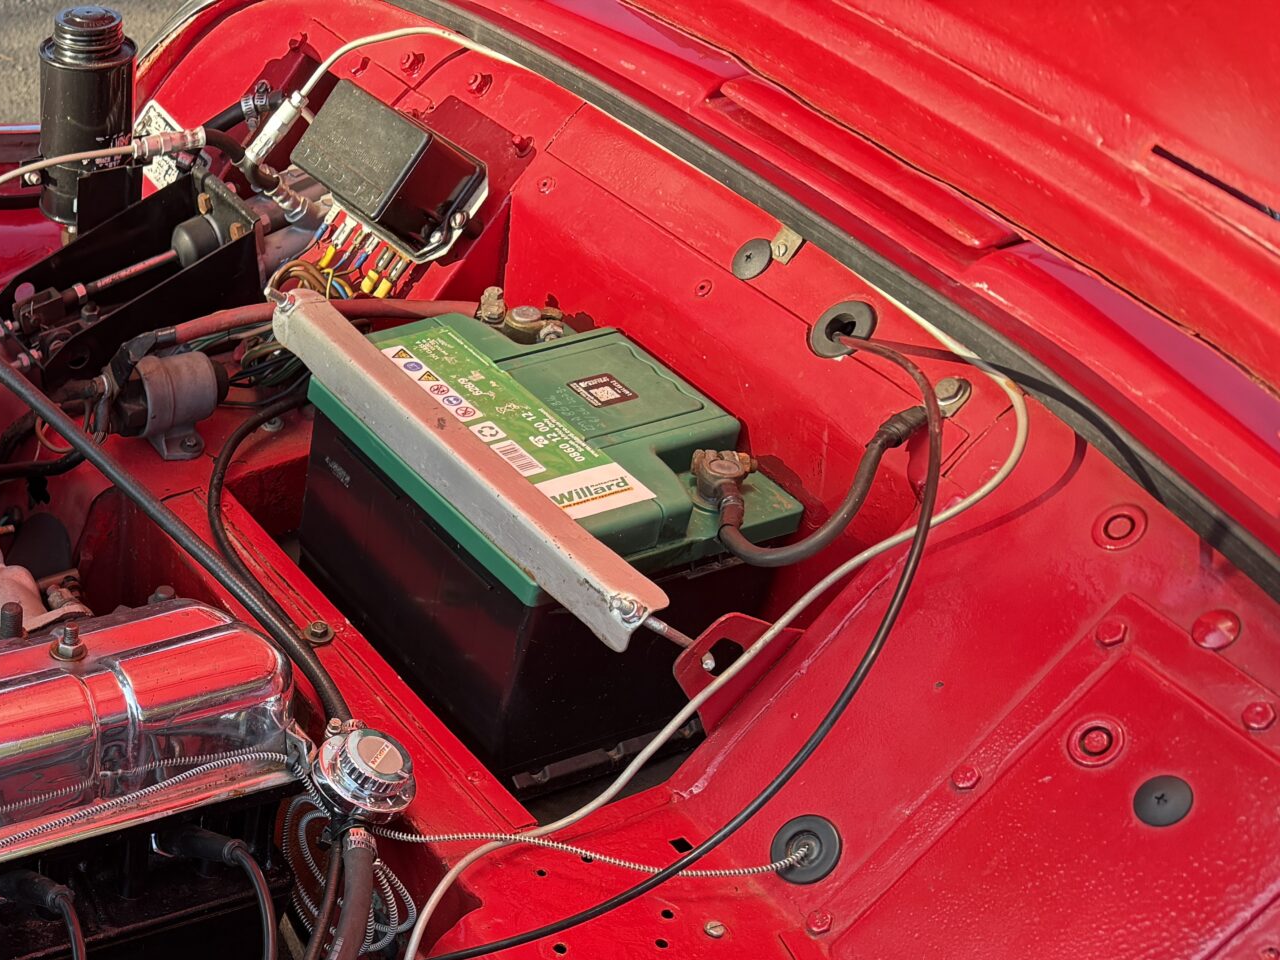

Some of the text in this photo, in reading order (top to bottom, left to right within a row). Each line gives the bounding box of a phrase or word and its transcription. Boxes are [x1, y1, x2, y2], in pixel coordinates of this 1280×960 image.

[519, 410, 586, 463] 0860 12 00 12
[549, 475, 630, 506] Willard
